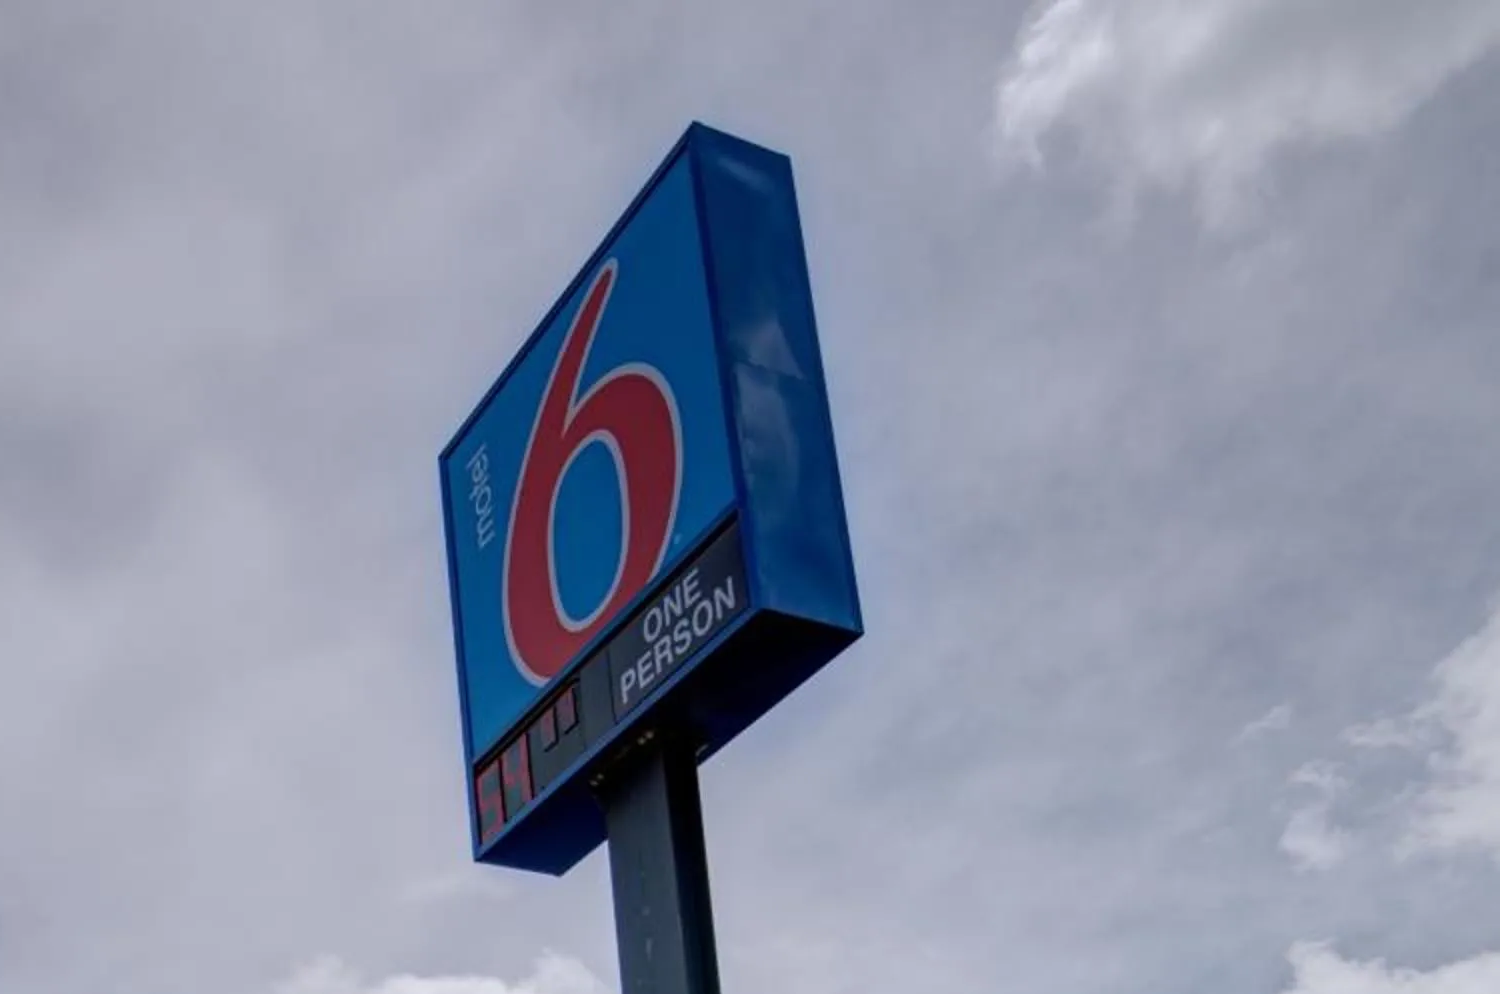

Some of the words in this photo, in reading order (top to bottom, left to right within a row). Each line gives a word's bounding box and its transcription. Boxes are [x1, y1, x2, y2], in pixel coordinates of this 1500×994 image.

[465, 443, 496, 550] motel
[502, 257, 683, 688] 6
[620, 575, 736, 704] PERSON
[643, 567, 702, 643] ONE
